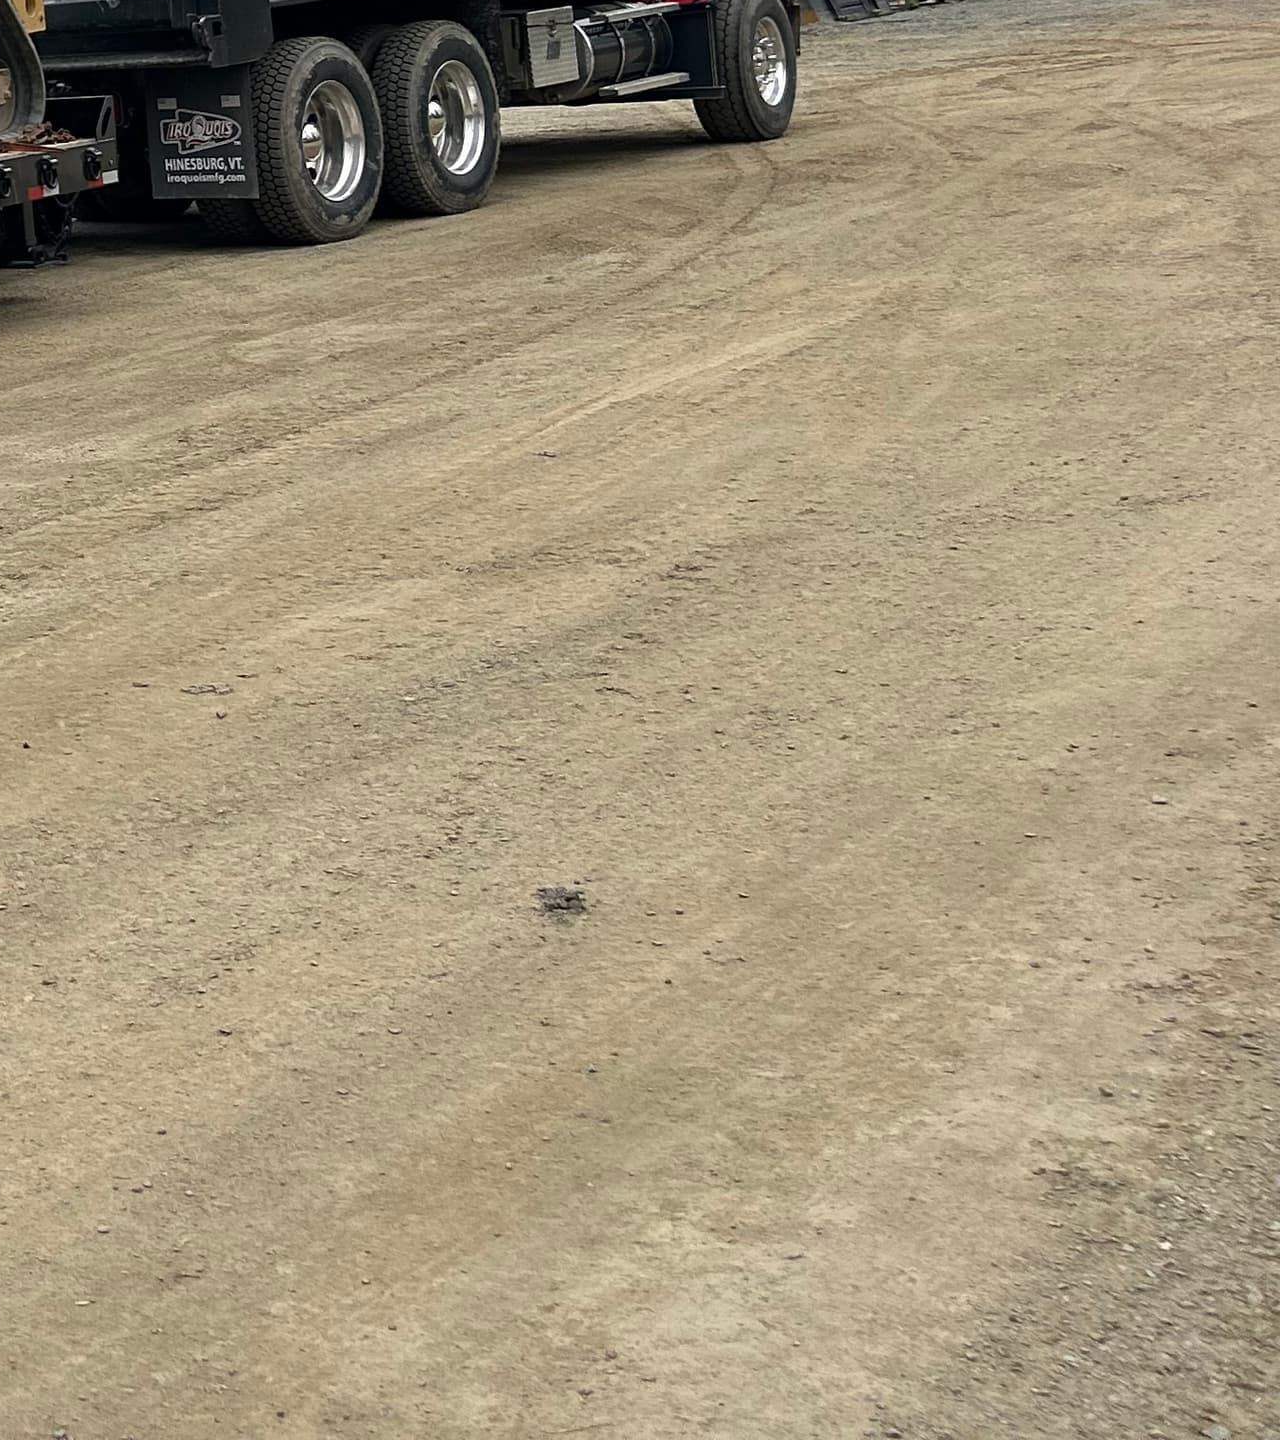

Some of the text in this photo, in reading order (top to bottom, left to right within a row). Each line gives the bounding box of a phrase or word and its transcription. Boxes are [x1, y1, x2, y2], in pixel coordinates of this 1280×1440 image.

[165, 157, 245, 171] HINESBURG, VT.
[167, 172, 246, 184] iroquoismfg.com
